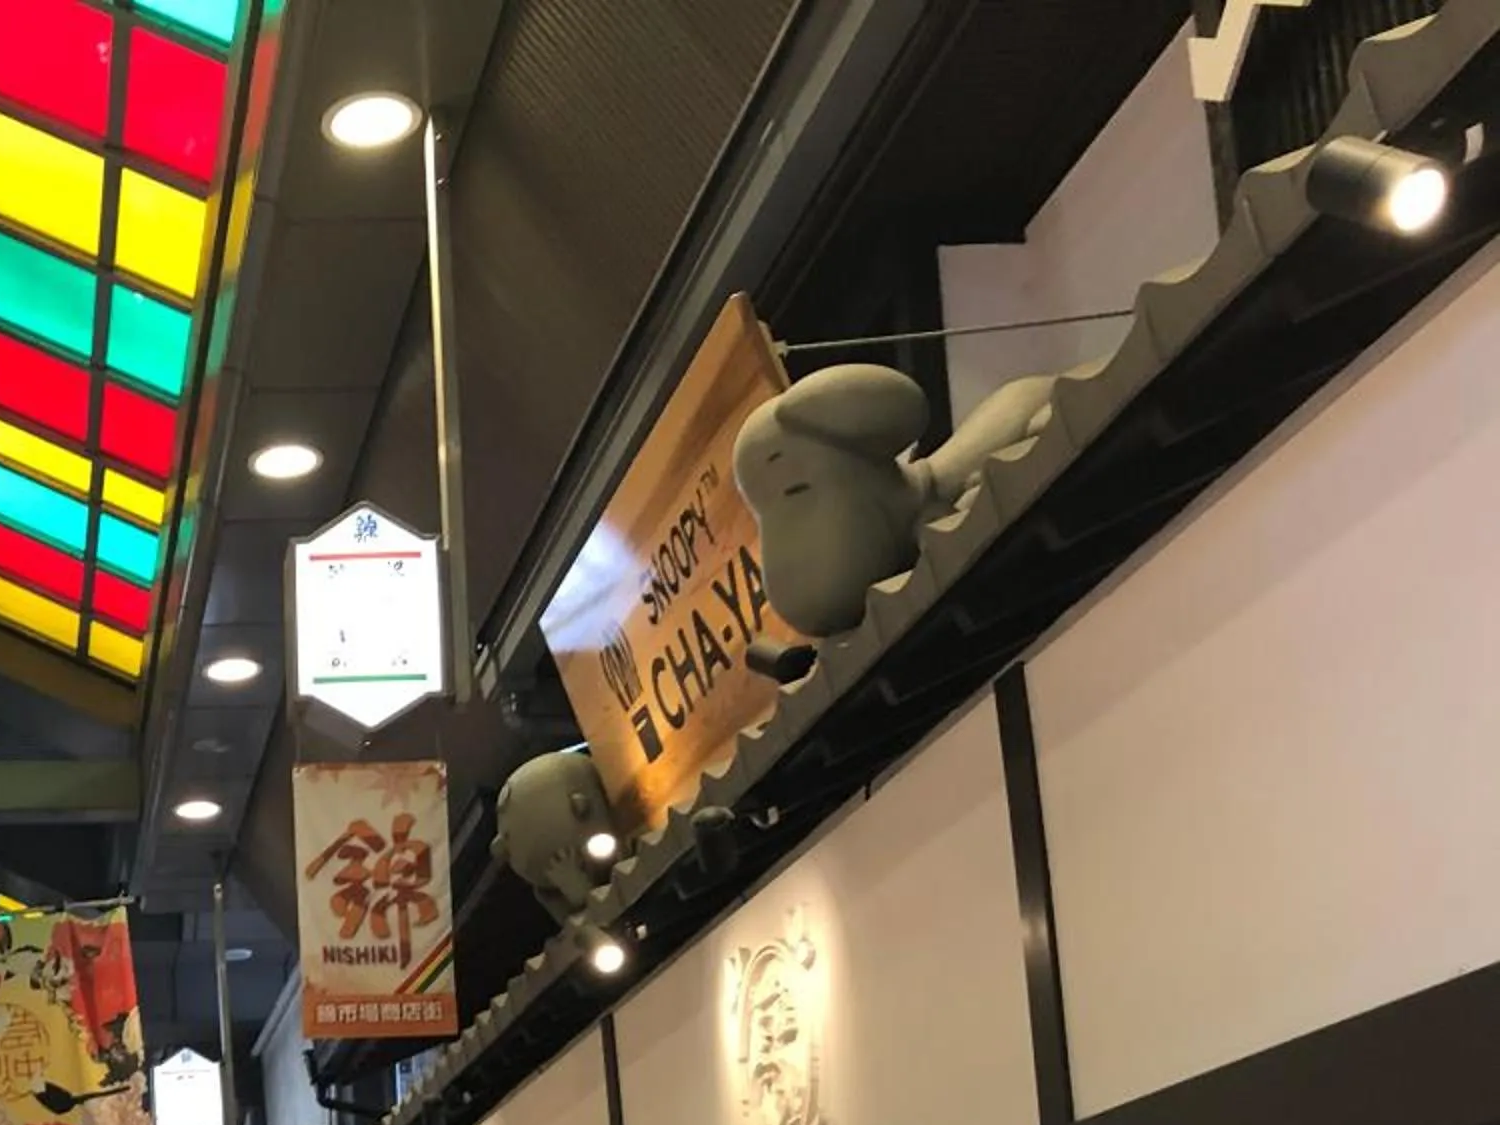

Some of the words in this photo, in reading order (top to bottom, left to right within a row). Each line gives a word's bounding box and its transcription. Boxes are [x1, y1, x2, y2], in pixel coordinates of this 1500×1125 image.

[639, 488, 715, 625] SNOOPY
[305, 812, 440, 970] 錦
[322, 944, 398, 966] NISHIKI
